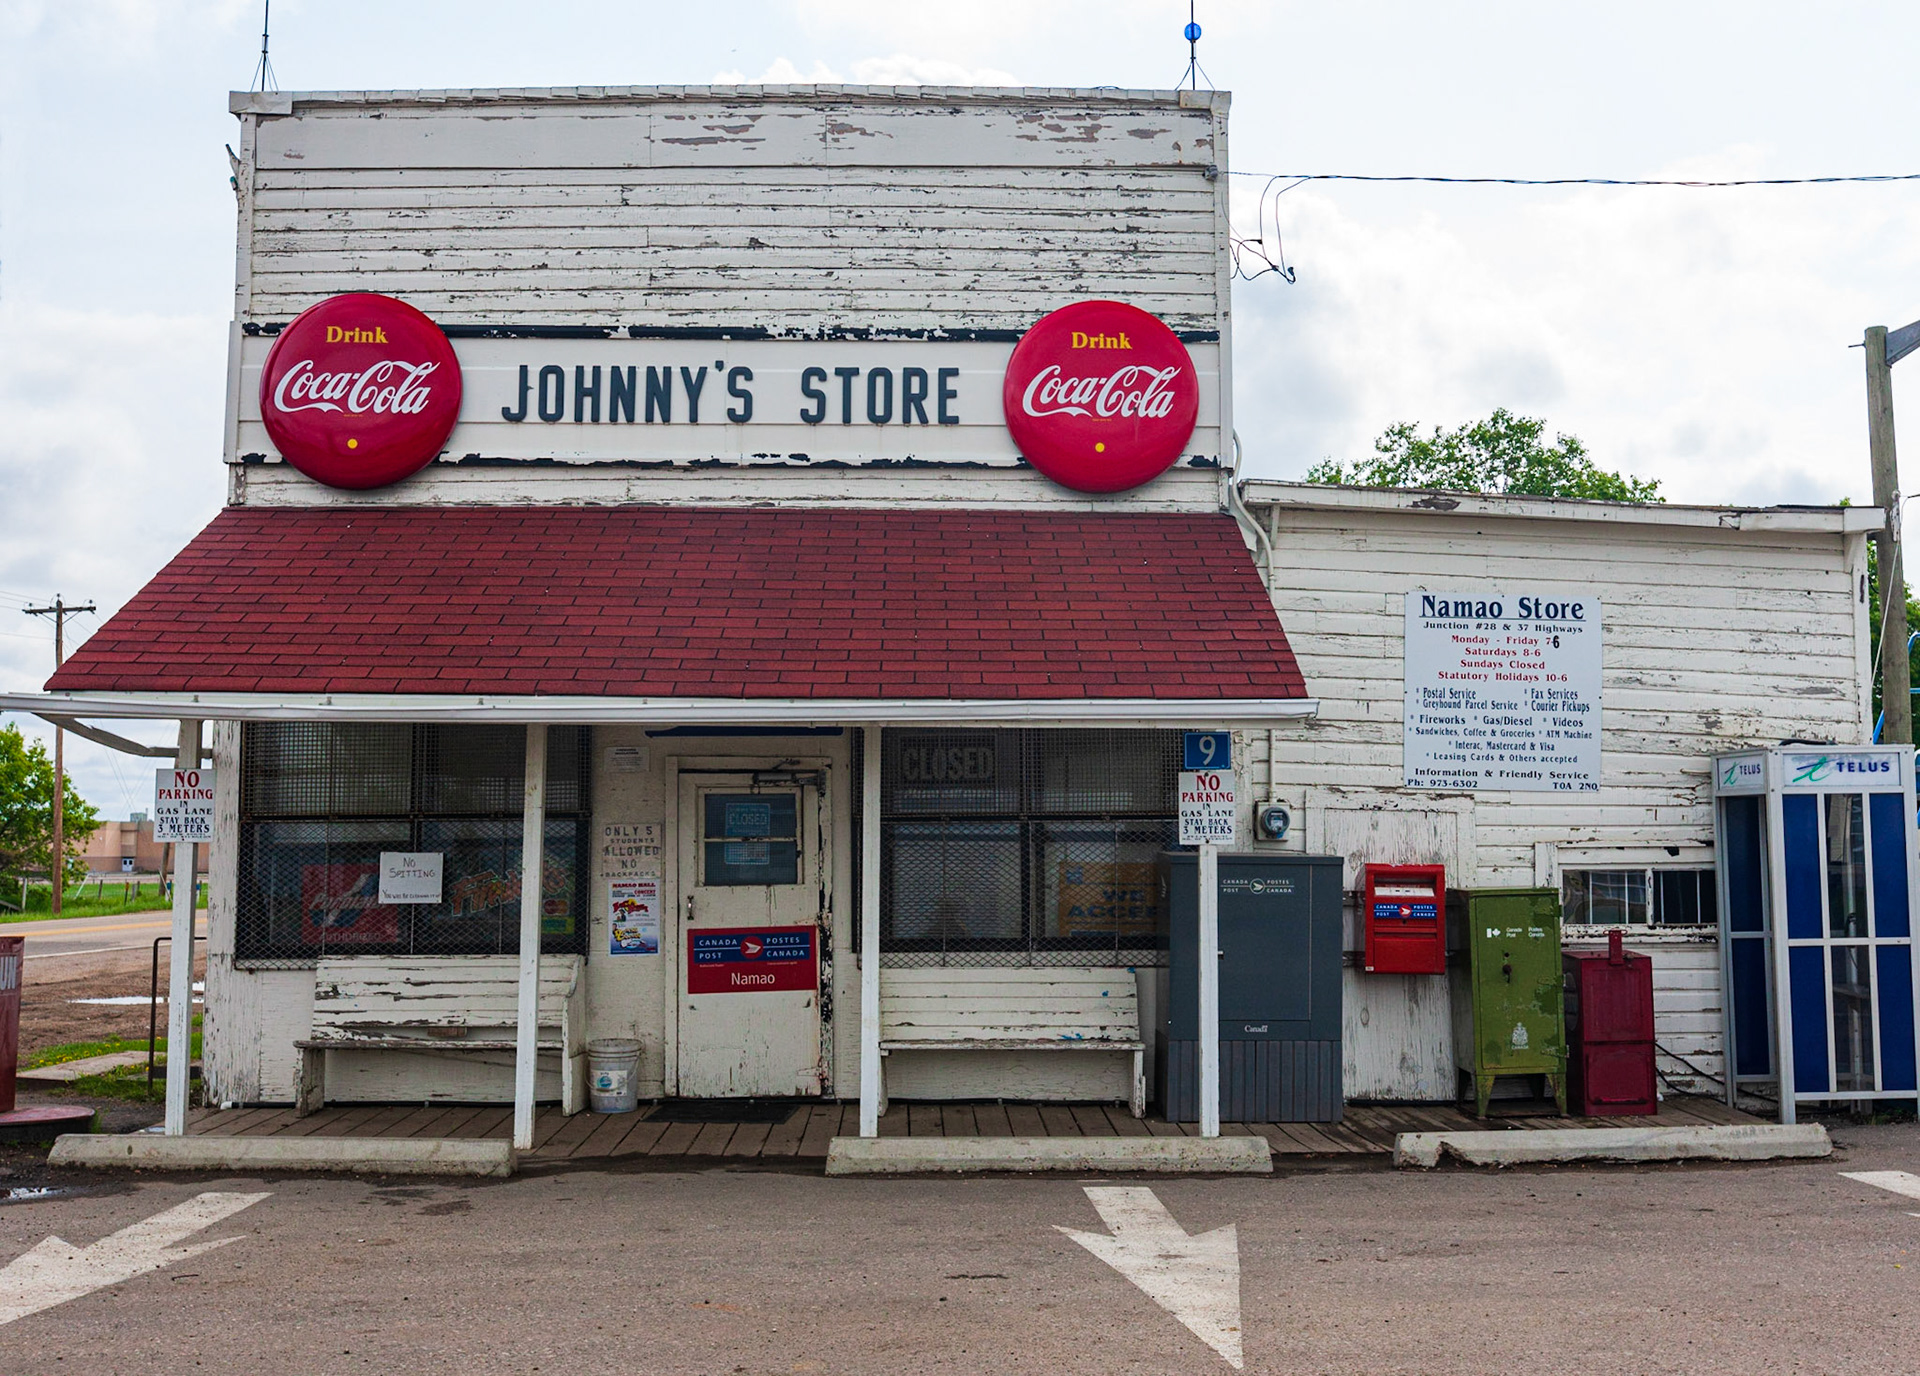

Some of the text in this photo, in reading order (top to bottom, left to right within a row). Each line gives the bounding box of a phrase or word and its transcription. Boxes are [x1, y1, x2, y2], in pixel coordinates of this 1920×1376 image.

[326, 326, 389, 345] Drink
[1071, 331, 1133, 350] Drink
[273, 359, 441, 416] Coca-Cola
[501, 359, 960, 425] JOHNNY'S STORE
[1022, 364, 1181, 419] Coca-Cola
[1422, 595, 1584, 620] Namao Store
[1423, 621, 1583, 635] Junction #28 & 37 Highways
[1451, 635, 1489, 645] Monday
[1506, 636, 1539, 647] Friday
[1464, 647, 1541, 658] Saturdays 8-6
[1460, 659, 1545, 670] Sundays Closed
[1438, 671, 1568, 683] Statutory Holidays 10-6
[1423, 687, 1477, 700] Postal Service
[1531, 688, 1579, 700] Fax Services
[1422, 699, 1518, 711] Greyhound Parcel Service
[1531, 700, 1590, 715] Courier Pickups
[1419, 714, 1584, 728] Fireworks Gas/Diesel Videos
[1463, 728, 1487, 737] Coffee
[1490, 729, 1497, 737] &
[1500, 729, 1535, 738] Groceries
[1546, 730, 1560, 738] ATM
[1563, 730, 1592, 739] Machine
[1198, 735, 1216, 766] 9
[1486, 741, 1526, 751] Mastercard
[1529, 742, 1536, 751] &
[1540, 742, 1555, 751] Visa
[902, 747, 994, 780] CLOSED
[1433, 752, 1467, 762] Leasing
[1470, 753, 1494, 761] Cards
[1509, 754, 1536, 762] Others
[1540, 755, 1578, 764] accepted
[1739, 763, 1761, 775] TELUS
[1836, 761, 1890, 773] TELUS
[174, 771, 200, 788] NO
[1415, 767, 1589, 780] Information & Friendly Service
[1196, 774, 1221, 791] NO
[1430, 779, 1478, 788] 973-6302
[158, 788, 213, 800] PARKING
[1181, 792, 1234, 803] PARKING
[179, 800, 188, 808] IN
[157, 807, 179, 815] GAS
[1181, 810, 1234, 818] GAS LANE
[160, 816, 179, 824] STAY
[729, 813, 768, 825] CLOSED
[1184, 818, 1203, 826] STAY
[158, 824, 210, 833] 3 METERS
[605, 825, 653, 837] ONLY 5
[1183, 825, 1233, 834] 3 METERS
[604, 846, 659, 857] ALLOWED
[403, 857, 416, 868] NO
[621, 859, 637, 869] NO
[389, 867, 436, 878] SPITTING
[699, 939, 738, 947] CANADA
[766, 936, 800, 944] POSTES
[699, 952, 722, 960] POST
[731, 972, 776, 985] Namao
